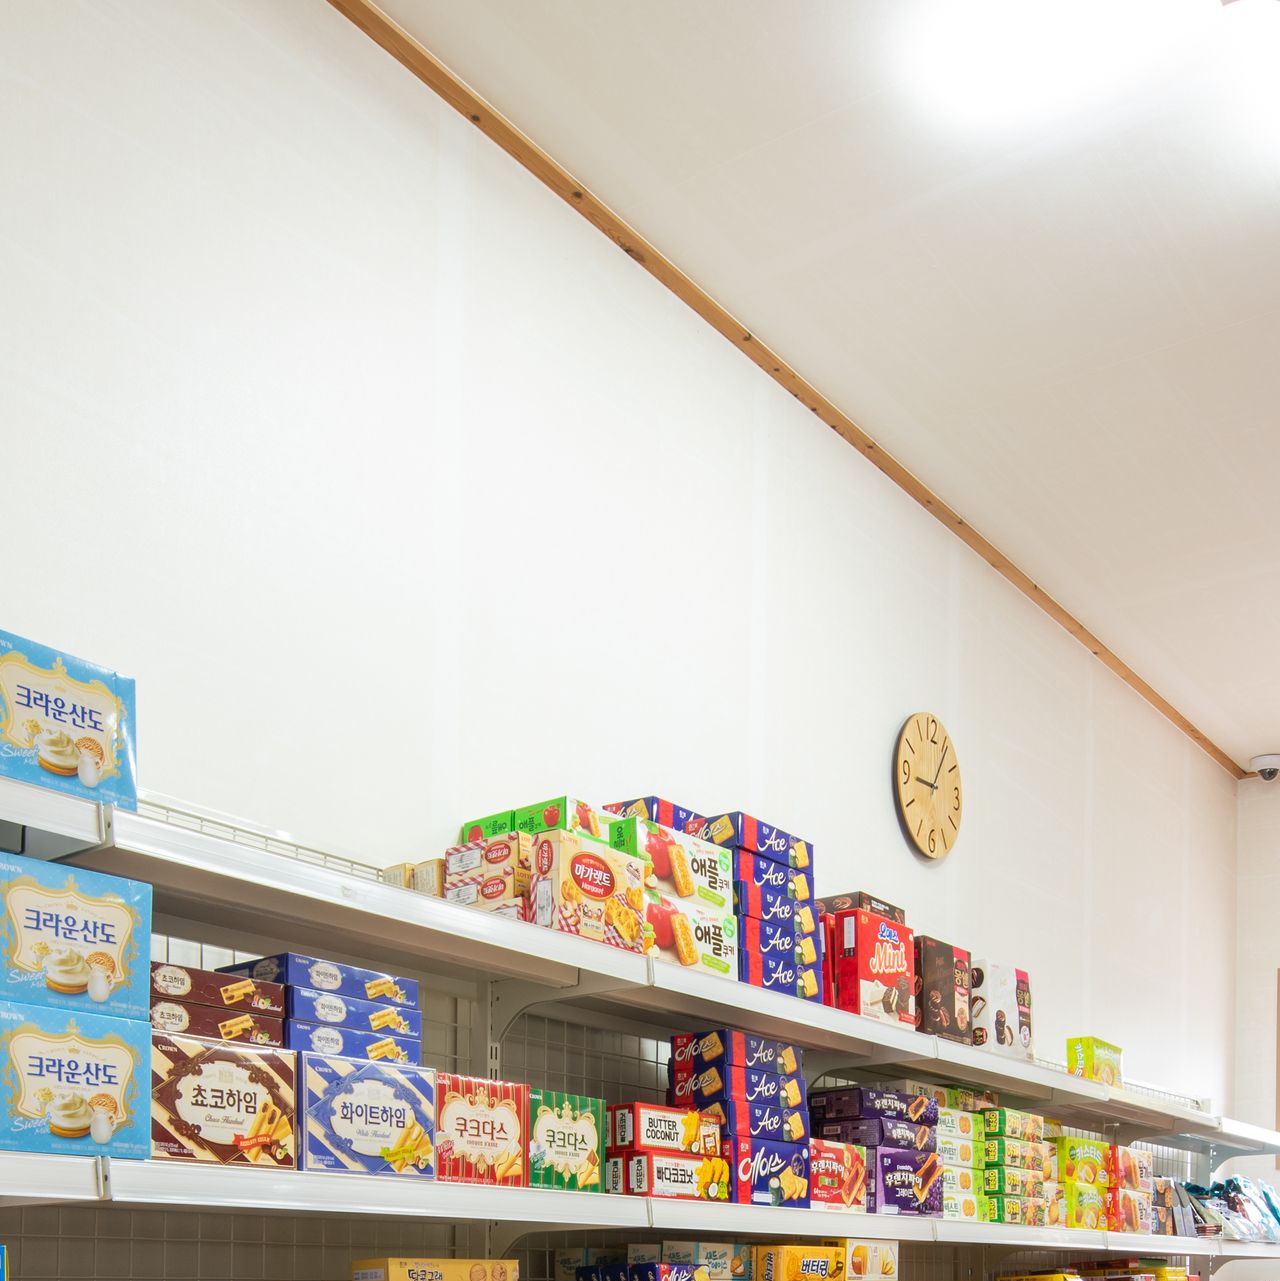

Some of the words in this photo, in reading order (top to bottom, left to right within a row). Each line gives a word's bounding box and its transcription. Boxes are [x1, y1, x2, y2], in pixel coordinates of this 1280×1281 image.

[15, 684, 105, 733] 크라운산도
[925, 718, 938, 745] 12
[901, 758, 912, 785] 9
[952, 786, 961, 811] 3
[755, 829, 788, 854] Ace
[927, 828, 937, 855] 6
[574, 863, 612, 887] 마가렛트
[691, 855, 720, 889] 애플
[754, 863, 786, 886] Ace
[762, 897, 792, 920] Ace
[23, 908, 118, 945] 크라운산도
[694, 923, 724, 957] 애플
[869, 938, 907, 974] Mini
[763, 962, 795, 987] Ace
[746, 1039, 775, 1067] Ace
[27, 1056, 119, 1087] 크라운산도
[191, 1084, 258, 1115] 쵸코하임
[746, 1075, 778, 1101] Ace
[340, 1101, 407, 1129] 화이트하임
[648, 1117, 678, 1130] BUTTER
[455, 1116, 510, 1141] 쿠크다스
[545, 1128, 589, 1151] 쿠크다스
[645, 1128, 680, 1143] COCONUT
[657, 1166, 694, 1185] 빠다코코낫
[885, 1170, 923, 1187] 후렌치파이
[801, 1258, 829, 1277] 버터링
